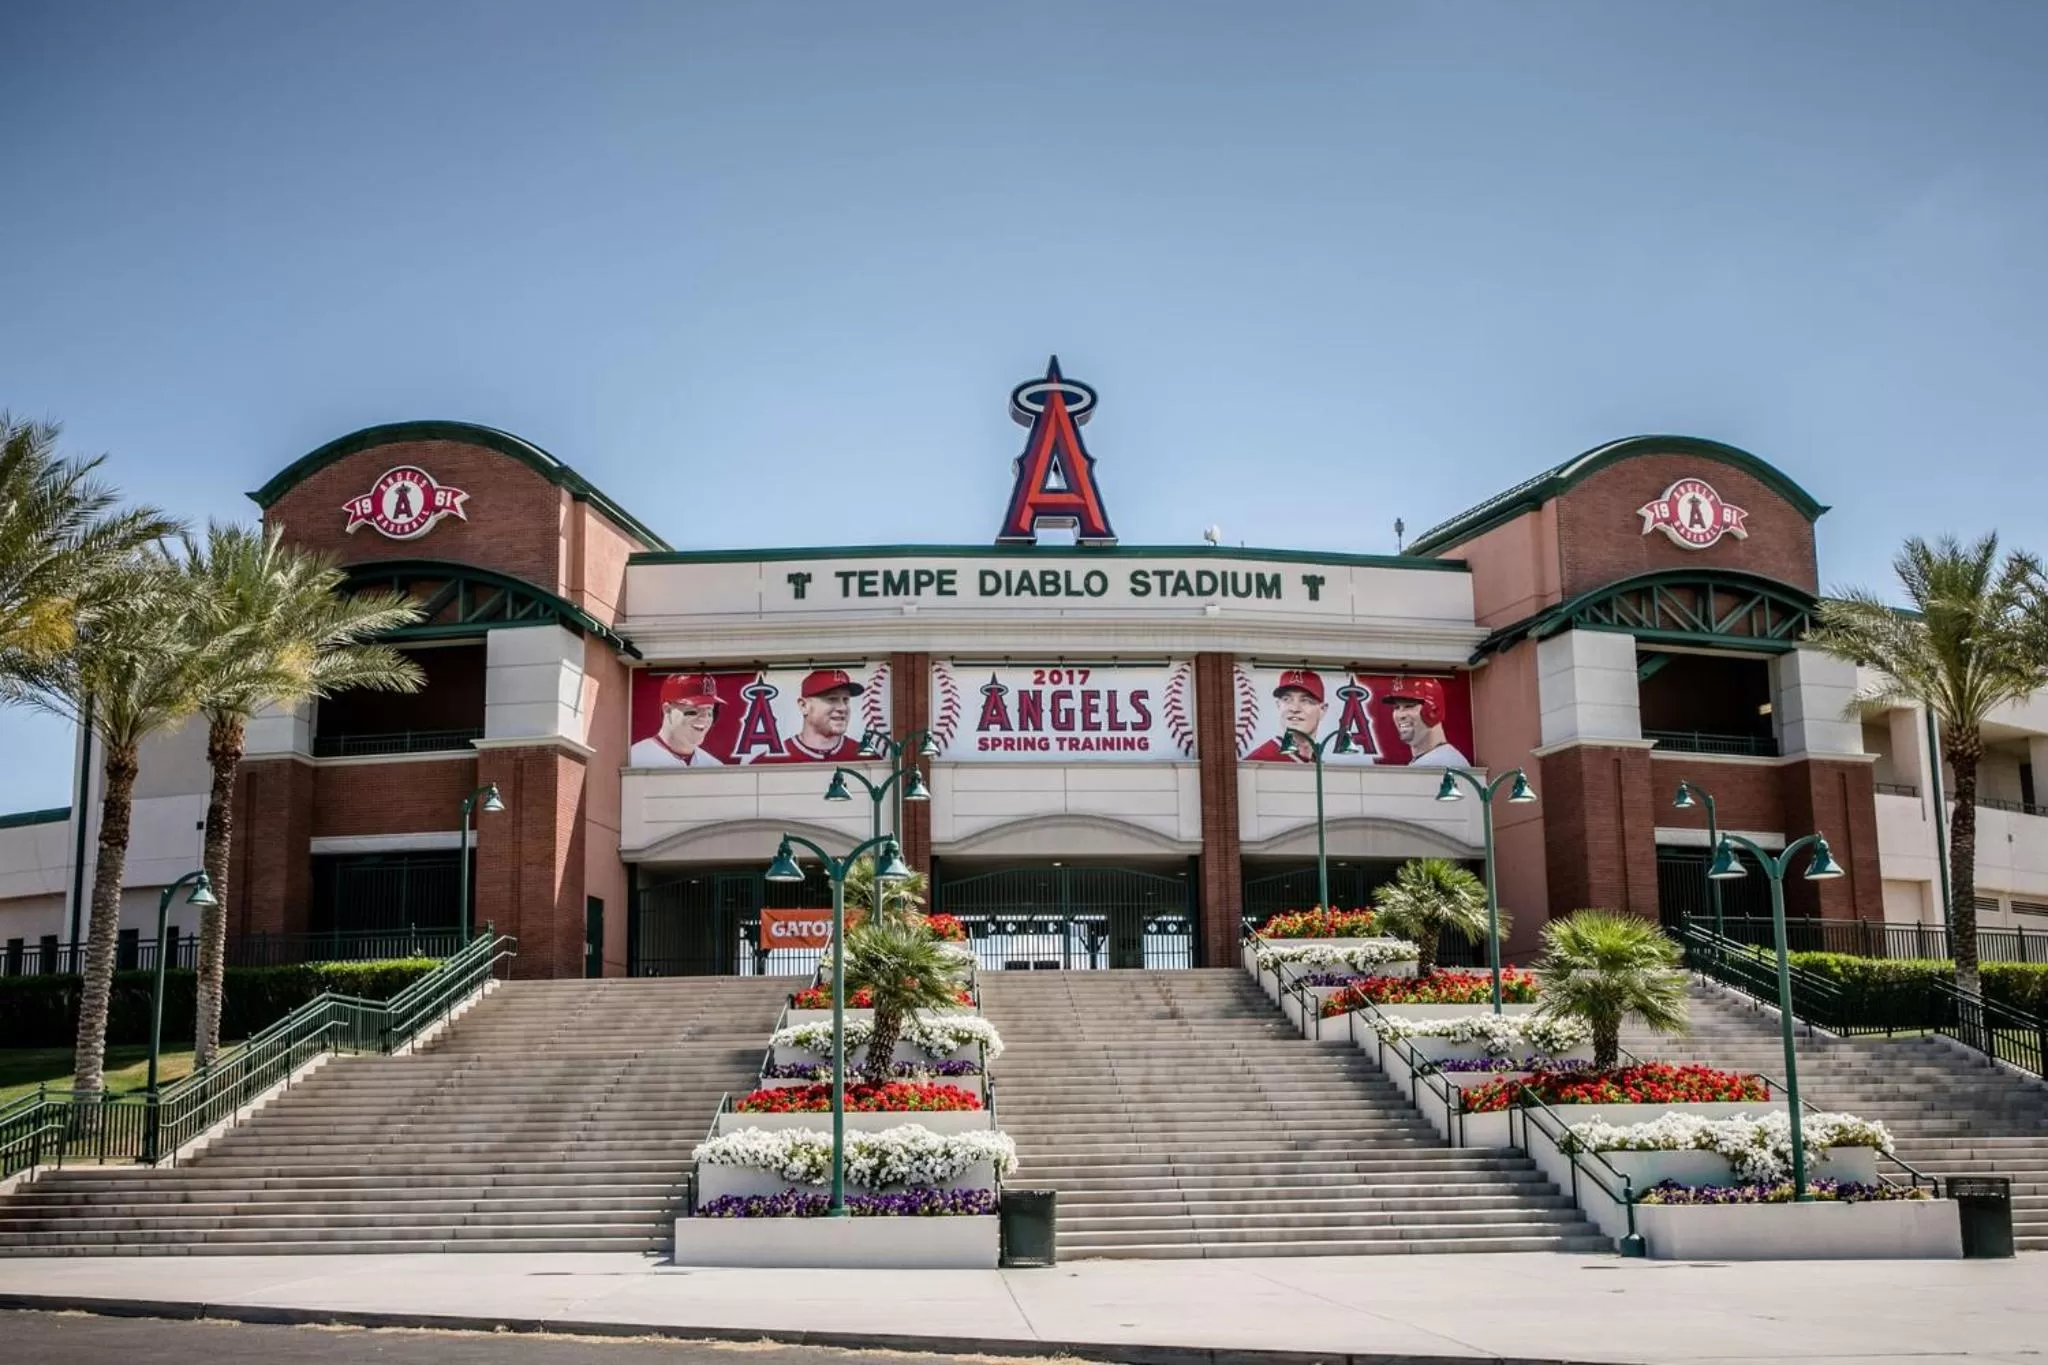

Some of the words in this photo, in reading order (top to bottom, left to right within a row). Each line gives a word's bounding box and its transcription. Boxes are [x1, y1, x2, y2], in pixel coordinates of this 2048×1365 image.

[998, 355, 1118, 546] A
[354, 498, 373, 517] 19
[393, 482, 414, 519] A
[434, 490, 453, 508] 61
[1653, 502, 1670, 520] 19
[1722, 507, 1738, 525] 61
[834, 569, 958, 598] TEMPE
[978, 569, 1108, 598] DIABLO
[1129, 569, 1283, 600] STADIUM
[1033, 669, 1091, 686] 2017
[976, 671, 1152, 732] ANGELS
[733, 673, 788, 756] A
[1333, 675, 1379, 755] A
[977, 736, 1050, 752] SPRING
[1056, 736, 1150, 752] TRAINING
